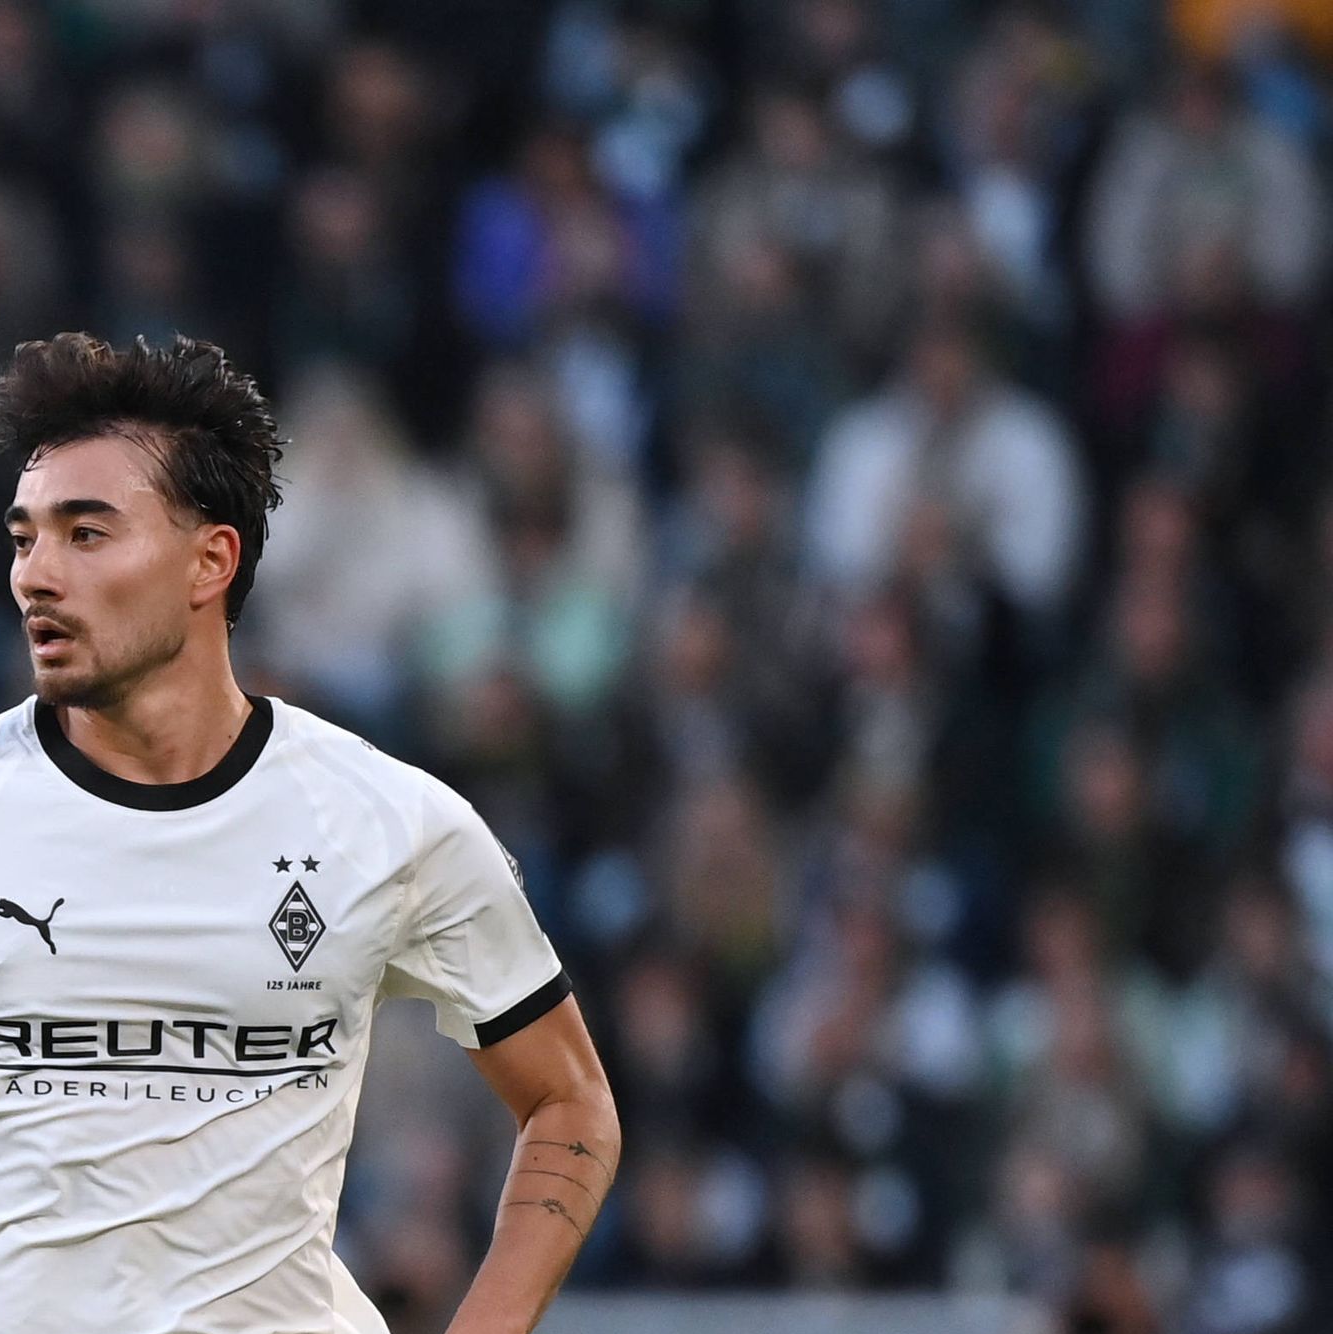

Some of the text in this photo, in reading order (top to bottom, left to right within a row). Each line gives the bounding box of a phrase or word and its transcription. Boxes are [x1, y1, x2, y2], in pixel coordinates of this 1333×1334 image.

[266, 981, 322, 991] 125 JAHRE
[145, 1073, 328, 1103] LEUCHEN
